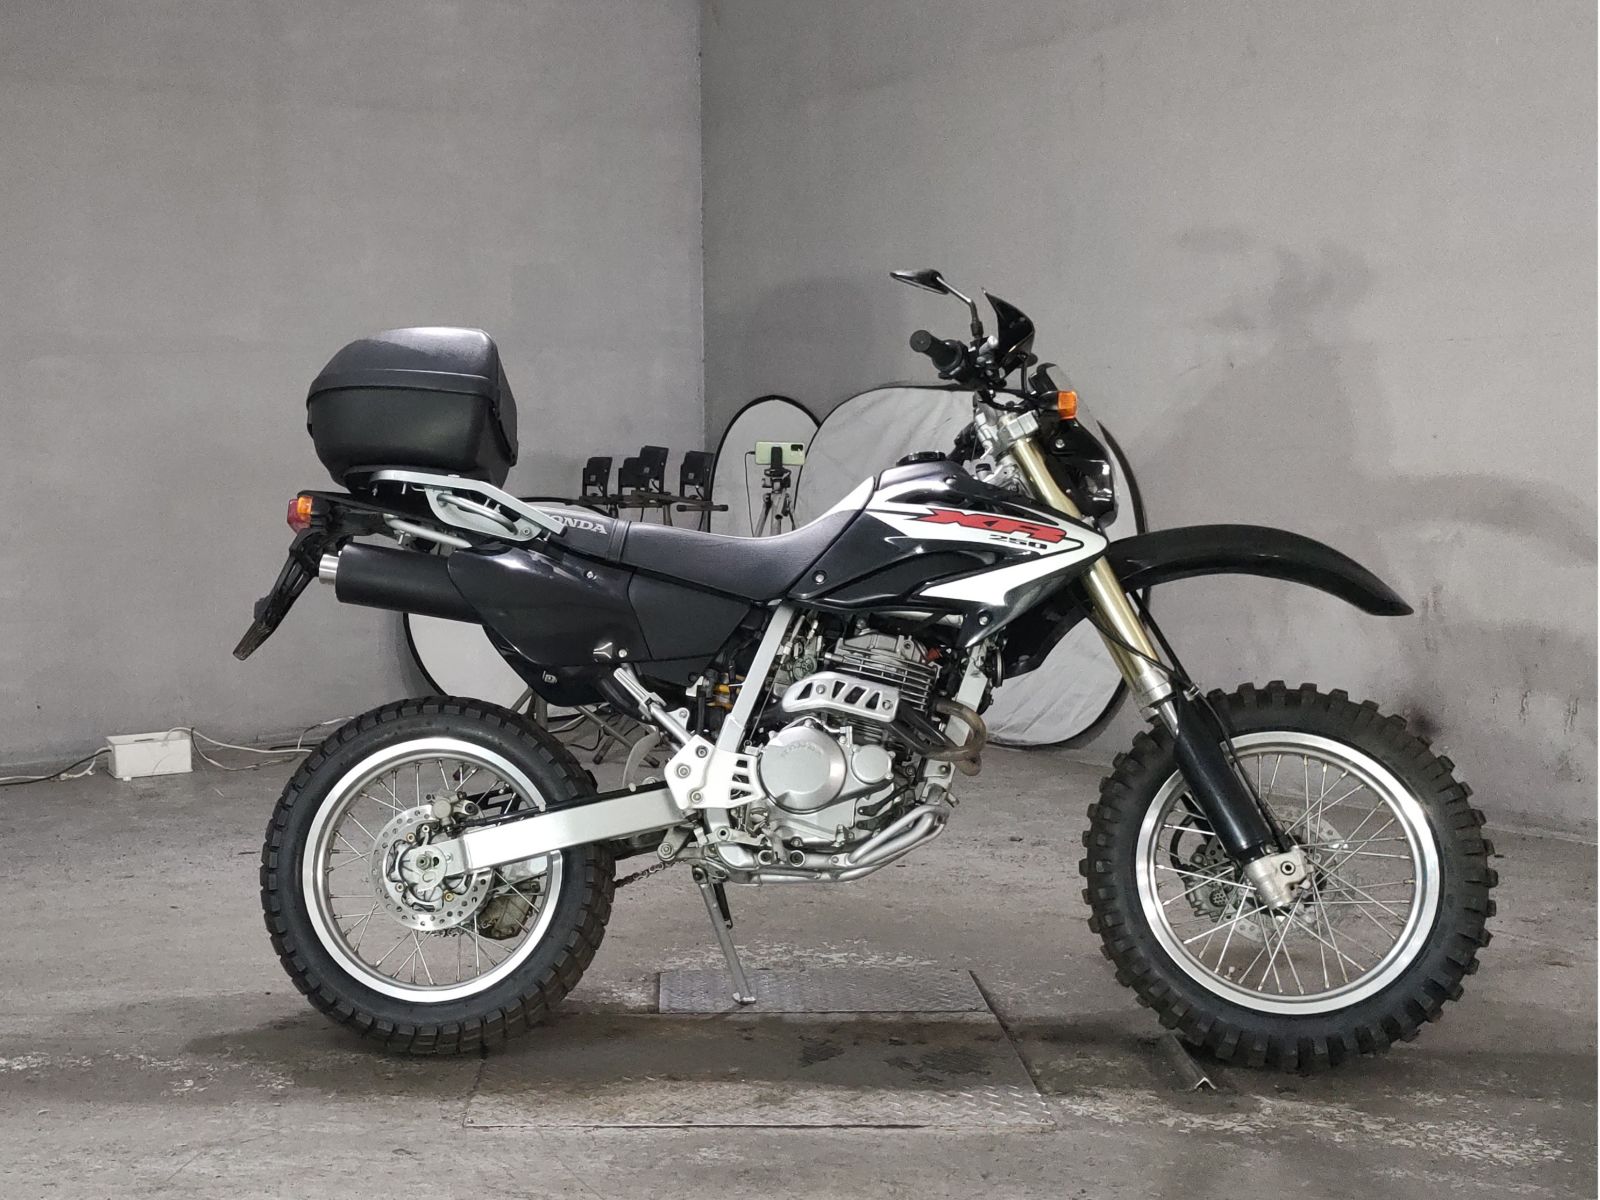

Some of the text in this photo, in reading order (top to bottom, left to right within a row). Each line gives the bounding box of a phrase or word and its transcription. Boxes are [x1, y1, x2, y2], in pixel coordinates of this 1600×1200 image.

[549, 515, 608, 534] ONDA
[908, 508, 1067, 543] XR
[989, 534, 1048, 550] 250
